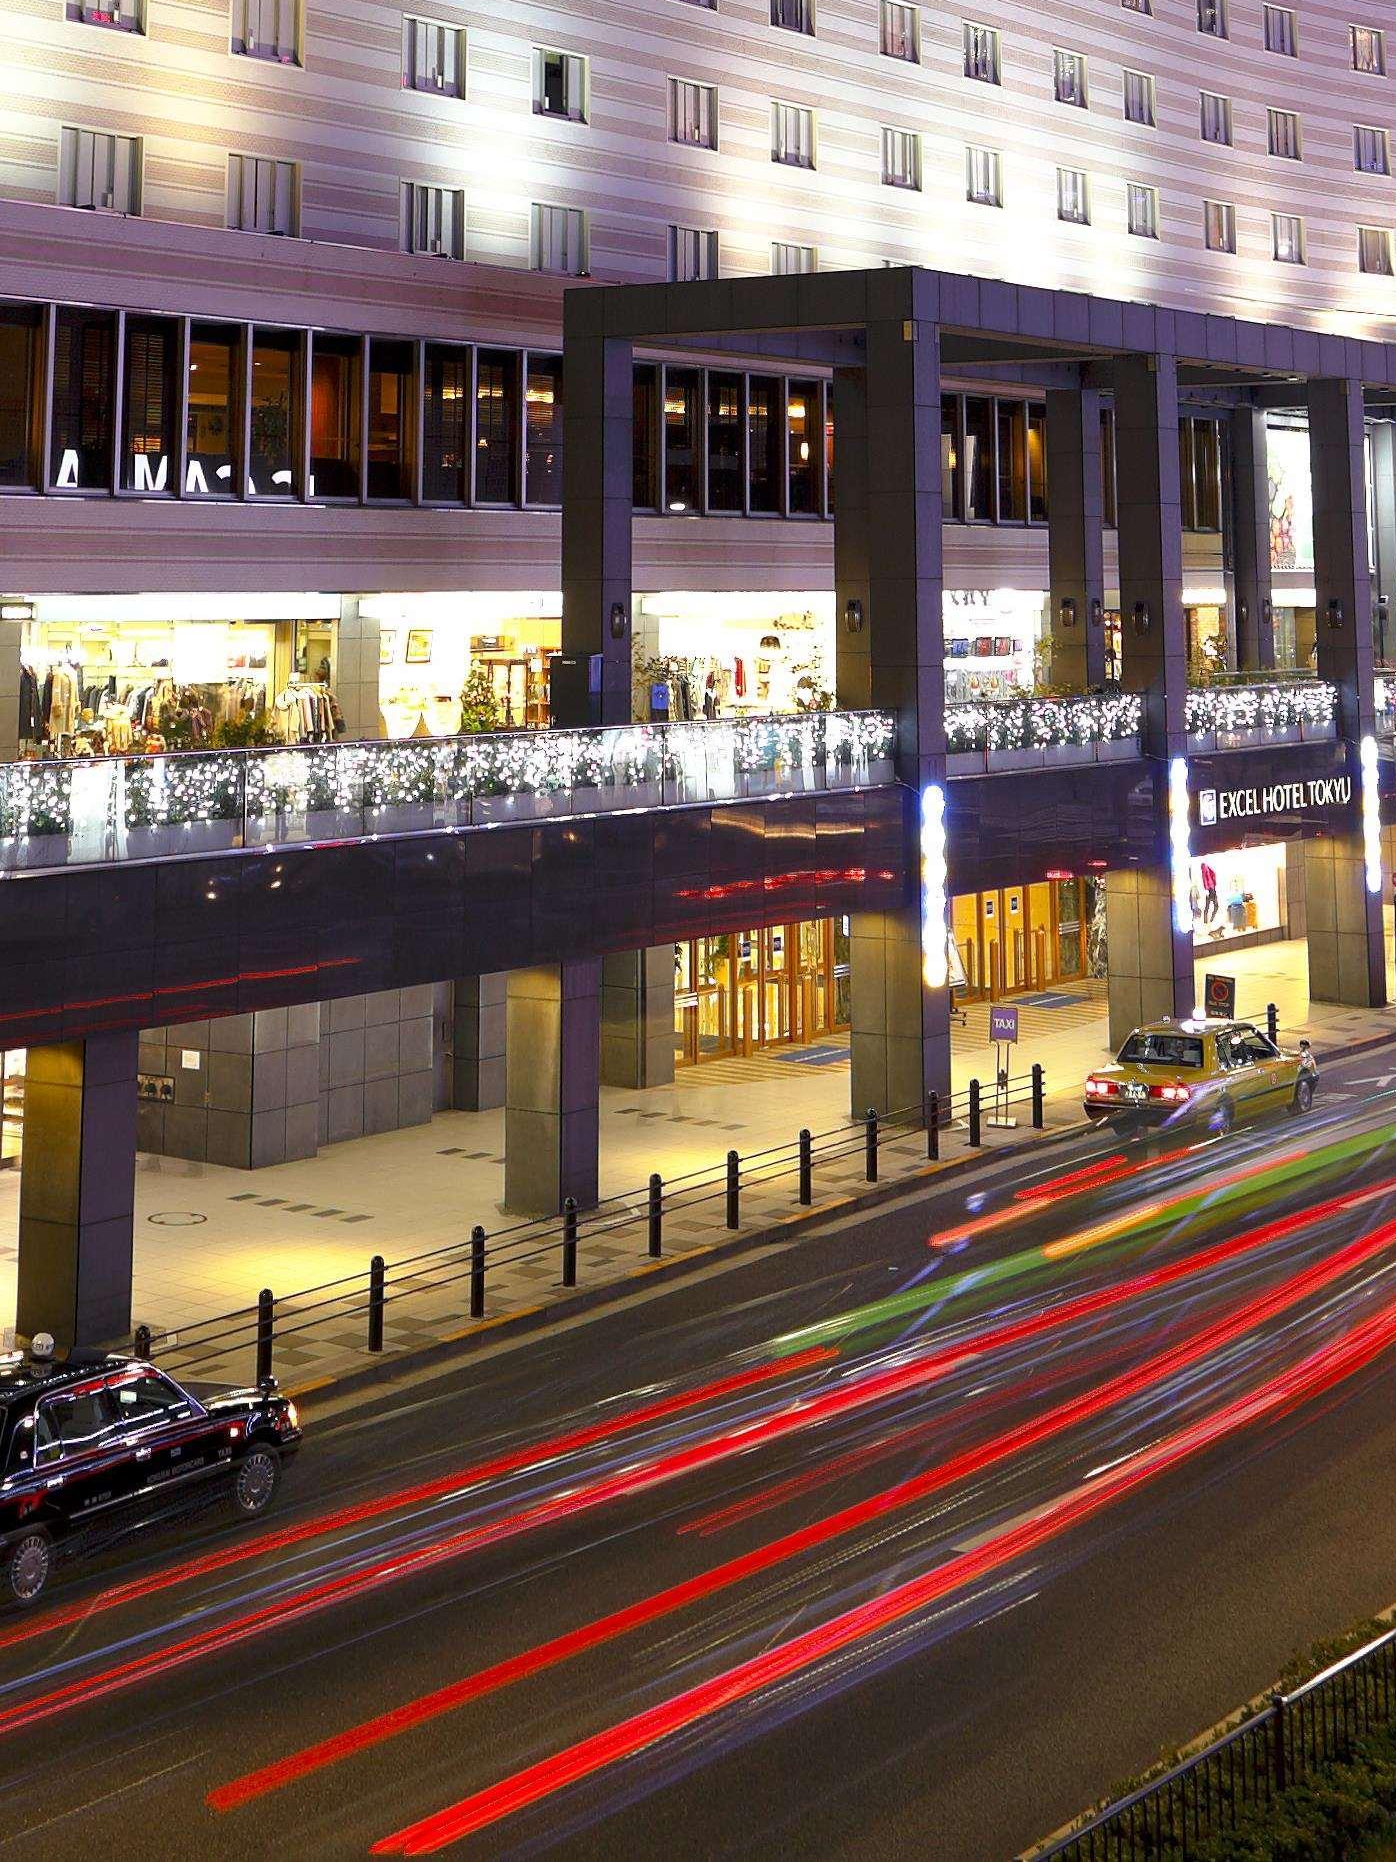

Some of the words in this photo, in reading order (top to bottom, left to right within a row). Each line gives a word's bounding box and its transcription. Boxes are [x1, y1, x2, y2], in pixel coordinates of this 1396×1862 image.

[1219, 788, 1261, 819] EXCEL
[1263, 782, 1308, 813] HOTEL
[1307, 776, 1351, 806] TOKYU
[993, 1018, 1015, 1030] TAXI
